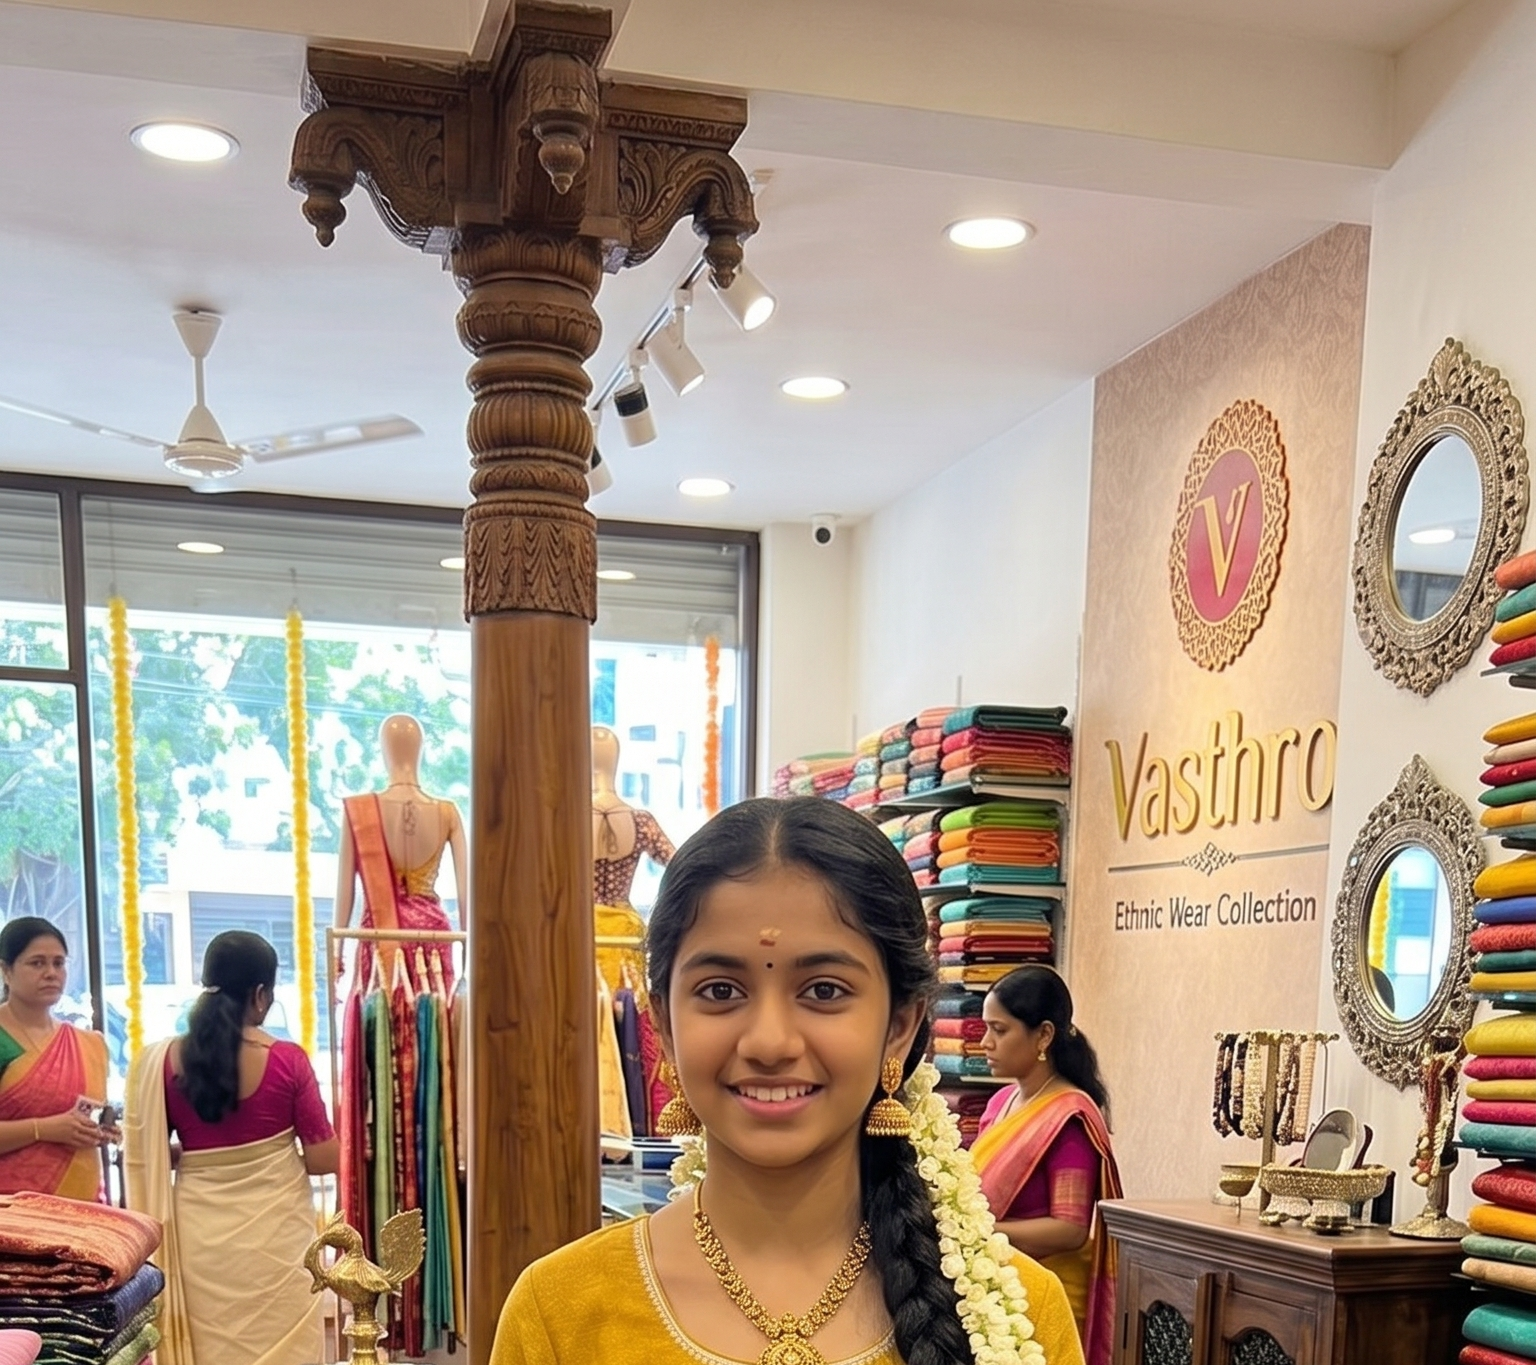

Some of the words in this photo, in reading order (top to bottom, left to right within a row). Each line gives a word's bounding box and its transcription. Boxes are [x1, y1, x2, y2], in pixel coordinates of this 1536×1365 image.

[1104, 710, 1337, 841] Vasthro
[1115, 900, 1163, 931] Ethnic
[1169, 896, 1211, 929] Wear
[1217, 889, 1317, 926] Collection
